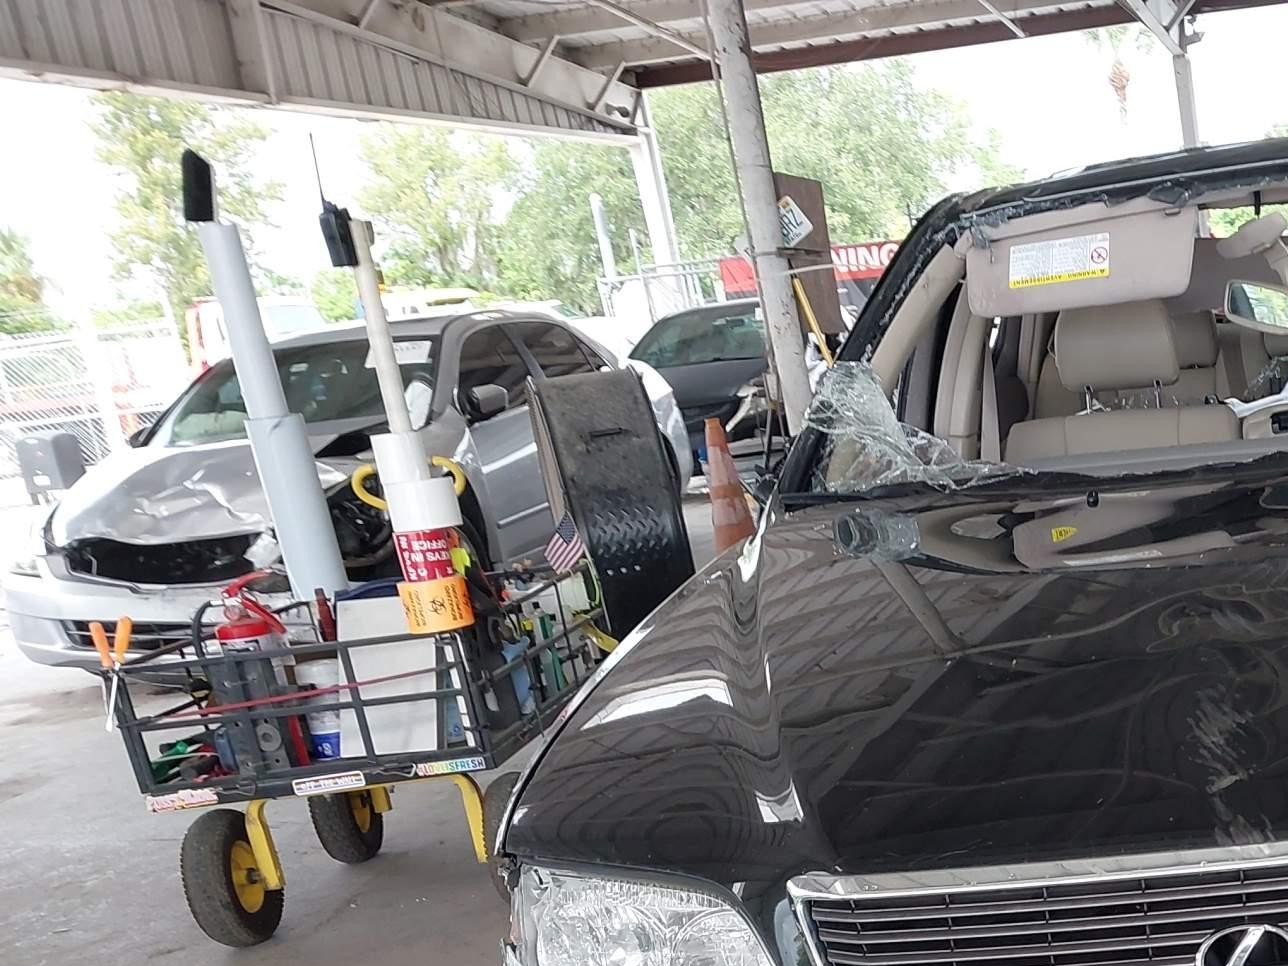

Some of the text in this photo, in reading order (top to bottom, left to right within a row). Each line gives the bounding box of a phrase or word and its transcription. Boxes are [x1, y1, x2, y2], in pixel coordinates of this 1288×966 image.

[1067, 269, 1097, 280] WARNING
[410, 539, 447, 551] OFFICE
[410, 552, 424, 563] IN
